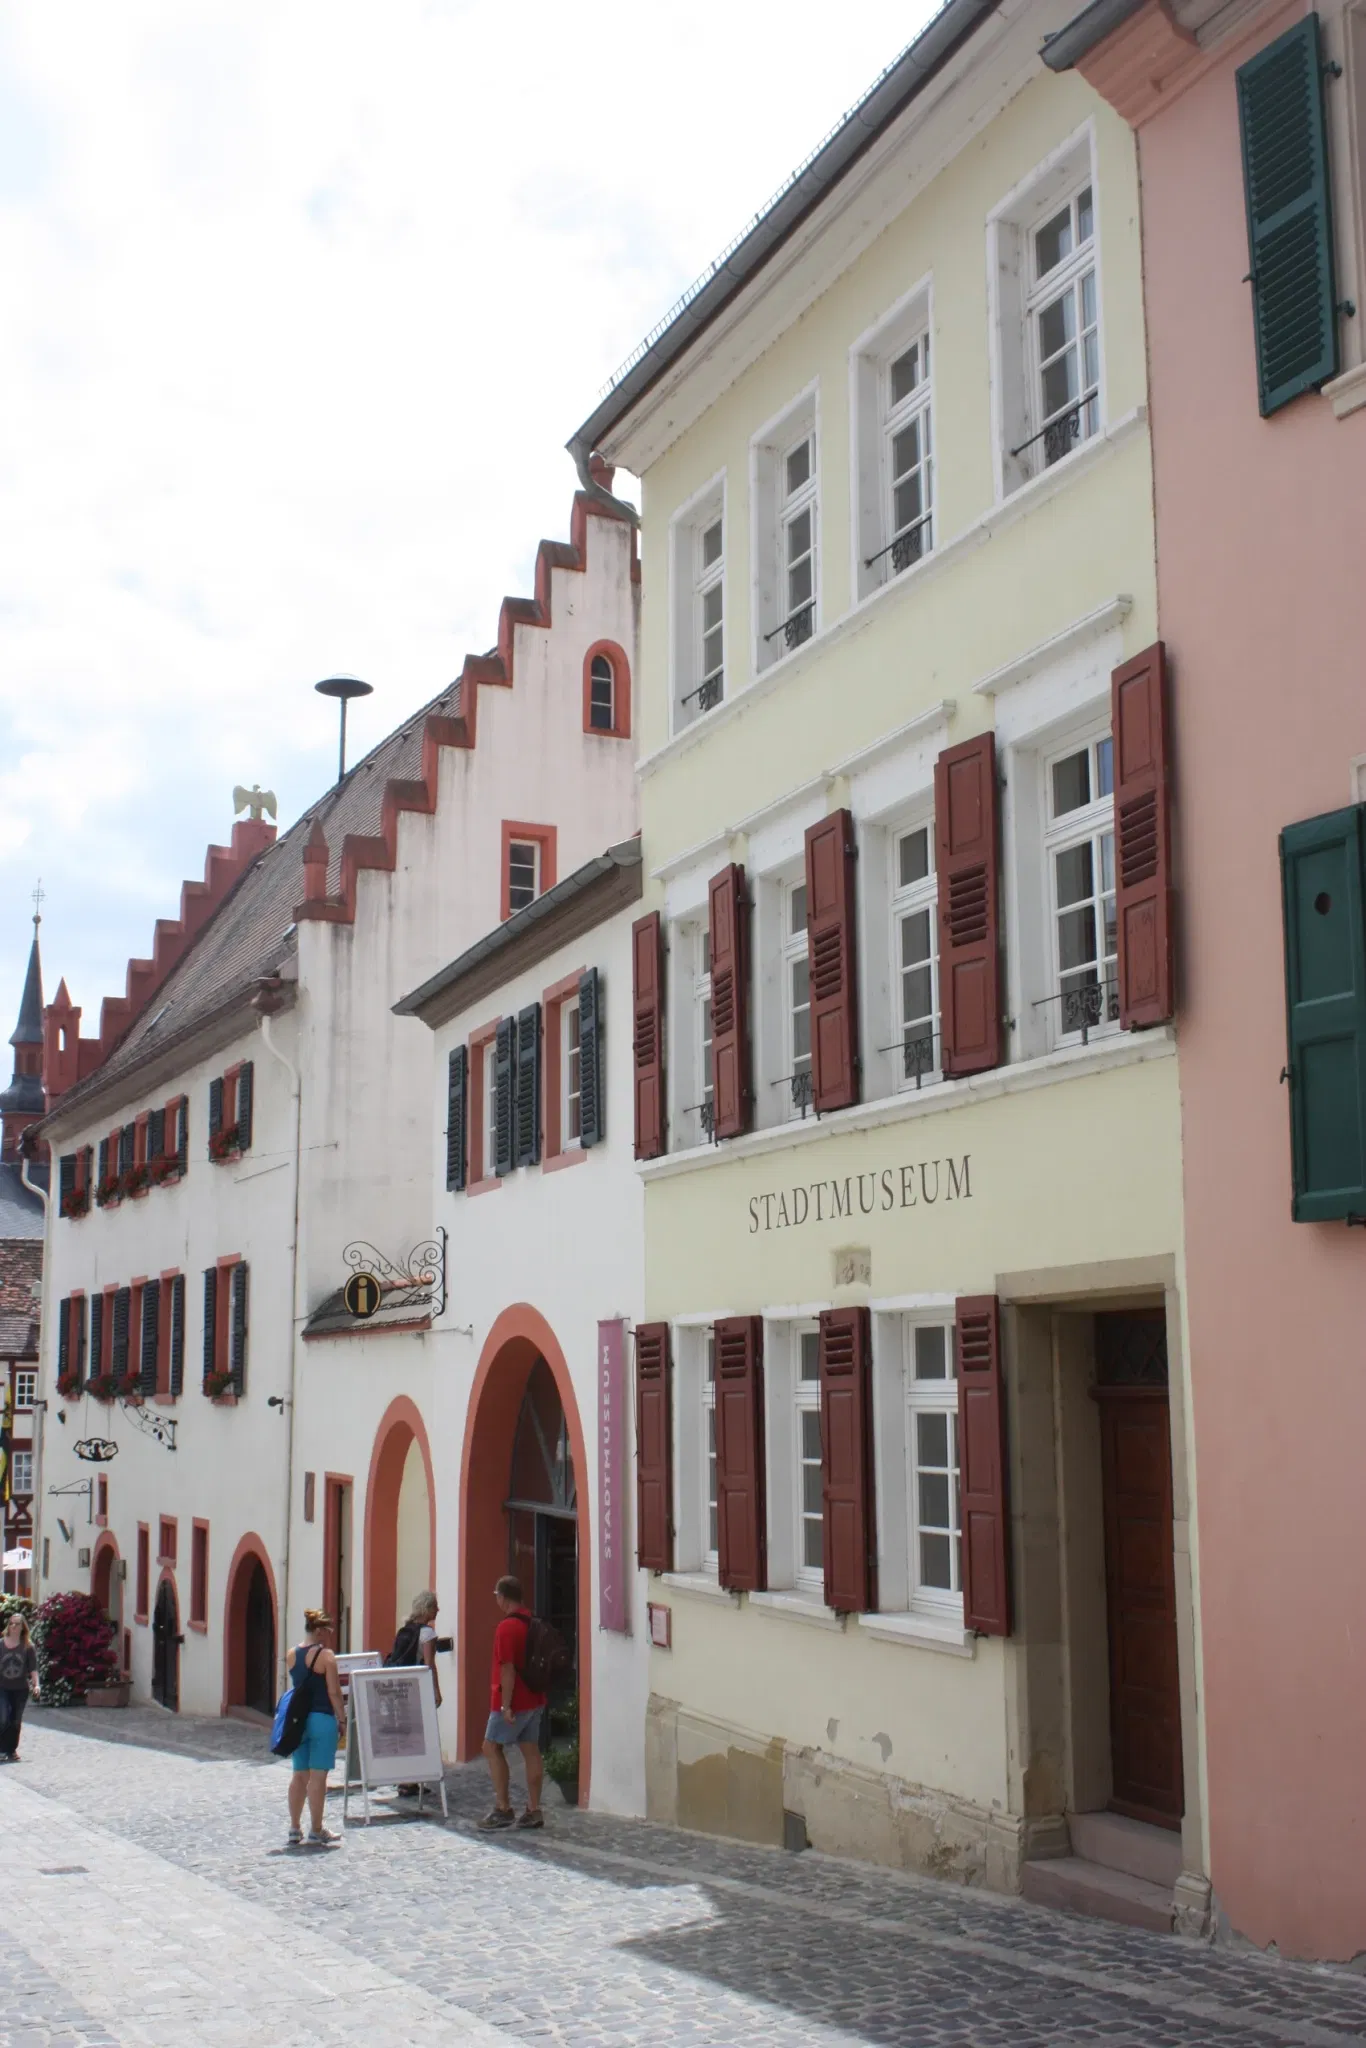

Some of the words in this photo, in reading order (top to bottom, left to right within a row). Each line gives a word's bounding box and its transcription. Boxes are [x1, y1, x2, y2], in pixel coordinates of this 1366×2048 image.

[749, 1155, 973, 1233] STADTMUSEUM
[358, 1278, 368, 1312] i
[603, 1345, 612, 1560] STADTMUSEUM
